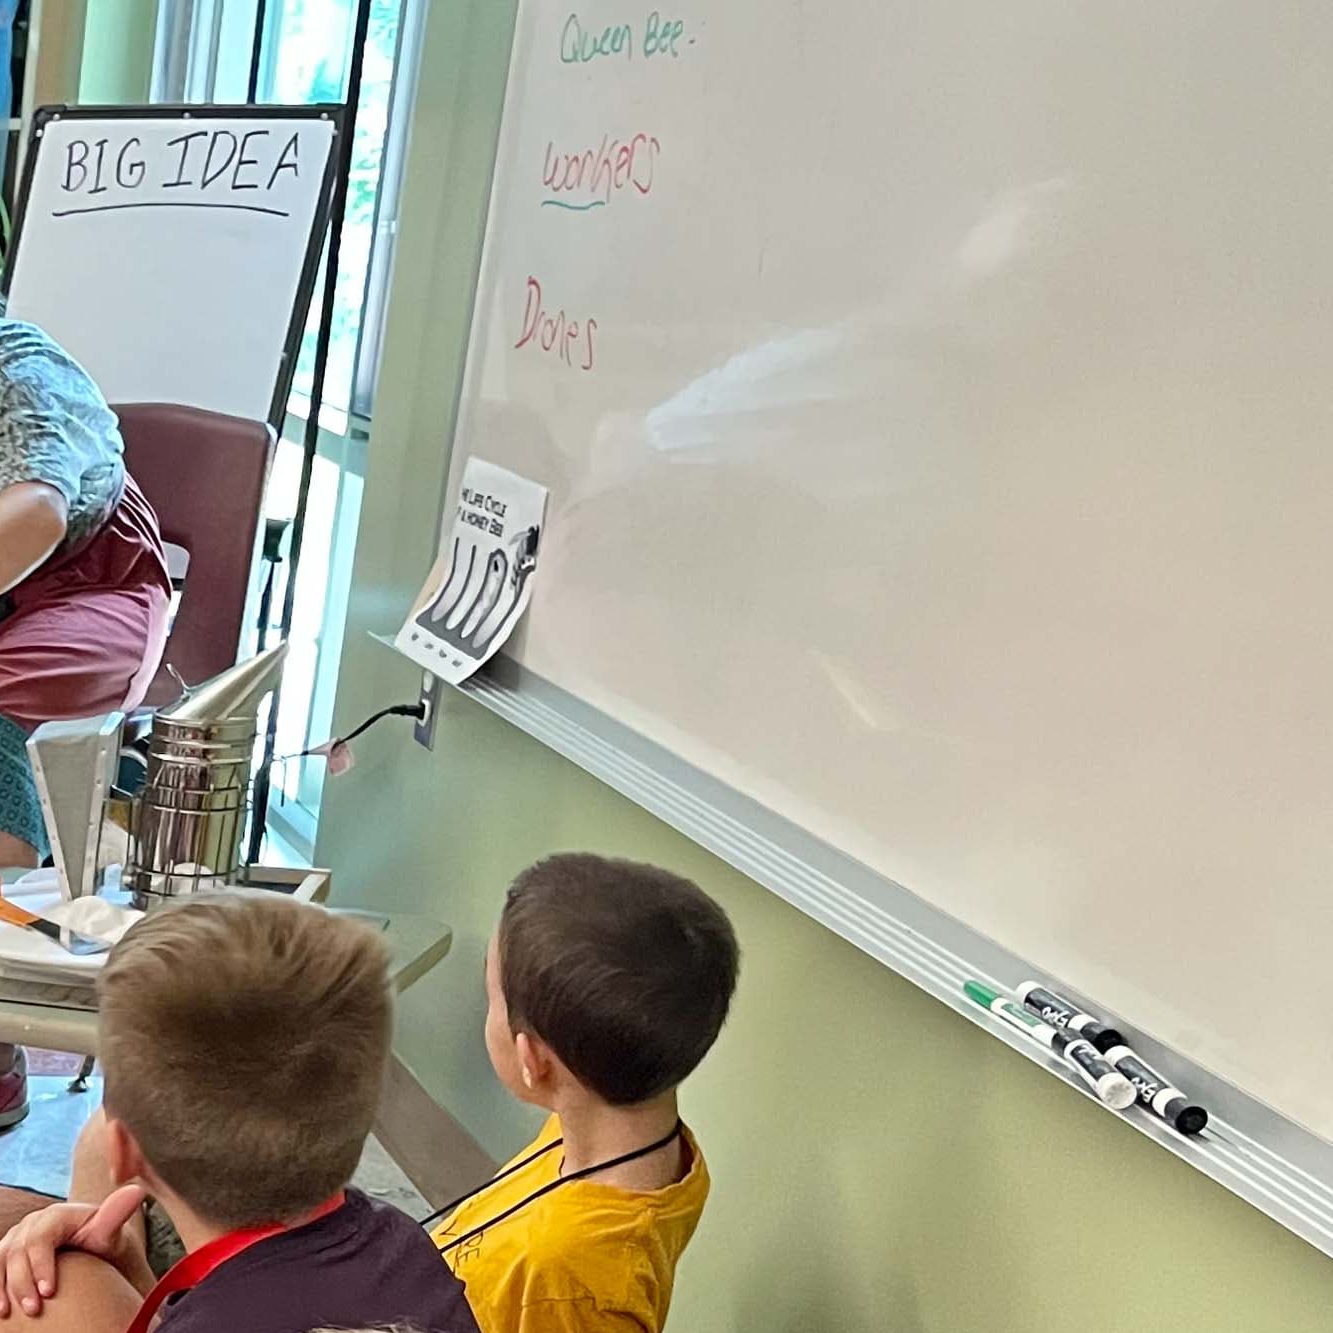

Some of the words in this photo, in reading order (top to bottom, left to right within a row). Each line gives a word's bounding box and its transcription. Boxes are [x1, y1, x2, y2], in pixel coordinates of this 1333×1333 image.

[560, 13, 632, 63] Queen
[60, 137, 146, 194] BIG
[162, 130, 299, 190] IDEA
